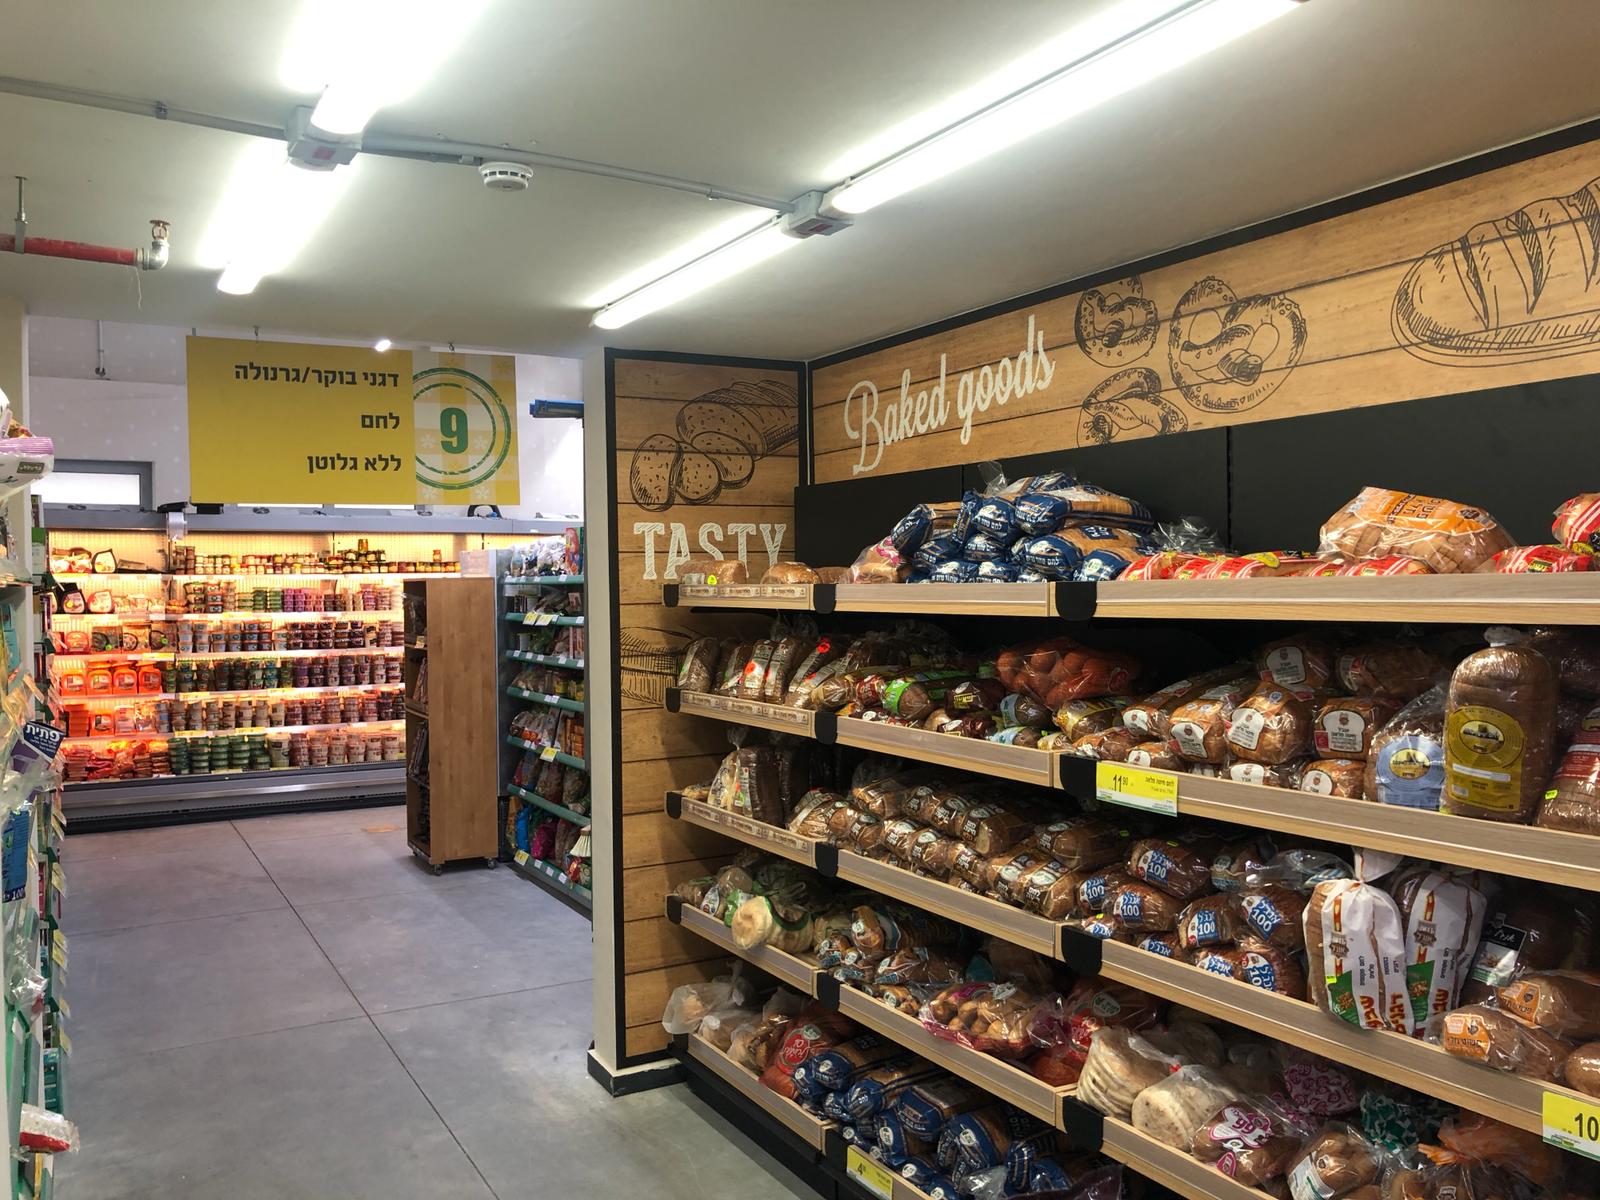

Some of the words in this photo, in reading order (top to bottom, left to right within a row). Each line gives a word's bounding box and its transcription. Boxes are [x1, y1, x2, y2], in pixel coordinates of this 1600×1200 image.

[234, 362, 358, 388] בוקר/גרנולה
[362, 371, 400, 388] דגני
[843, 354, 950, 475] Baked
[956, 315, 1057, 446] goods
[361, 412, 401, 430] לחם
[439, 407, 469, 454] 9
[307, 453, 358, 474] גלוטן
[364, 454, 402, 472] ללא
[633, 522, 787, 581] TASTY
[26, 724, 60, 742] פתית
[1148, 862, 1166, 879] 100
[1087, 885, 1105, 899] 100
[1122, 904, 1139, 916] 100
[1198, 922, 1215, 935] 100
[1251, 909, 1272, 932] 100
[1575, 1112, 1599, 1141] 10
